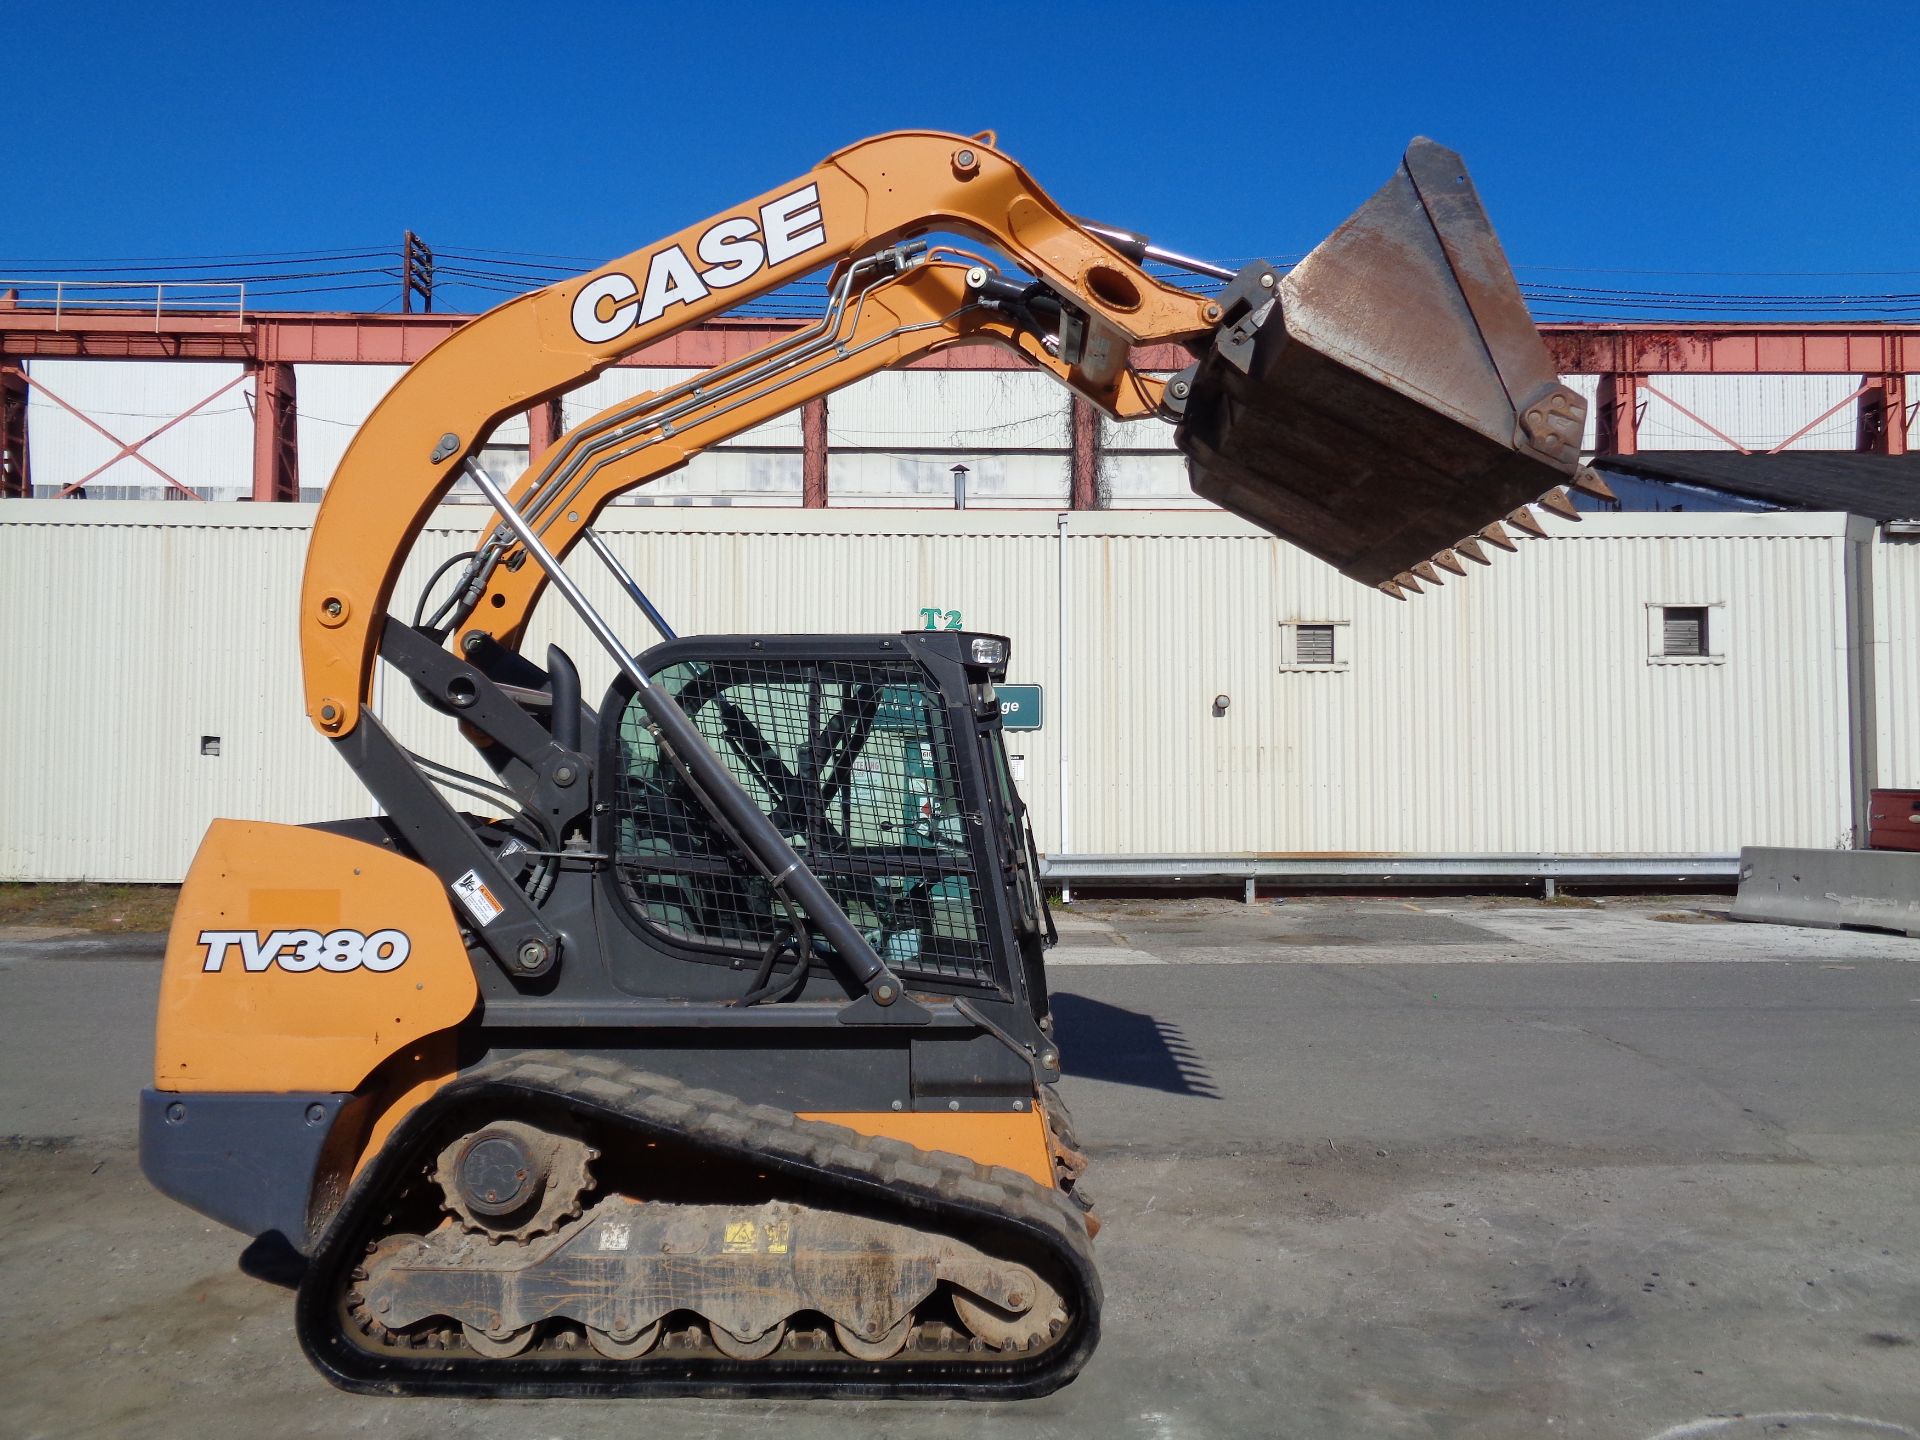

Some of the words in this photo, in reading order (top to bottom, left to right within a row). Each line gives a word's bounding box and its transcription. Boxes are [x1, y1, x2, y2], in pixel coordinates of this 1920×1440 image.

[570, 182, 826, 343] CASE
[1001, 702, 1019, 714] ge
[198, 929, 410, 972] TV380
